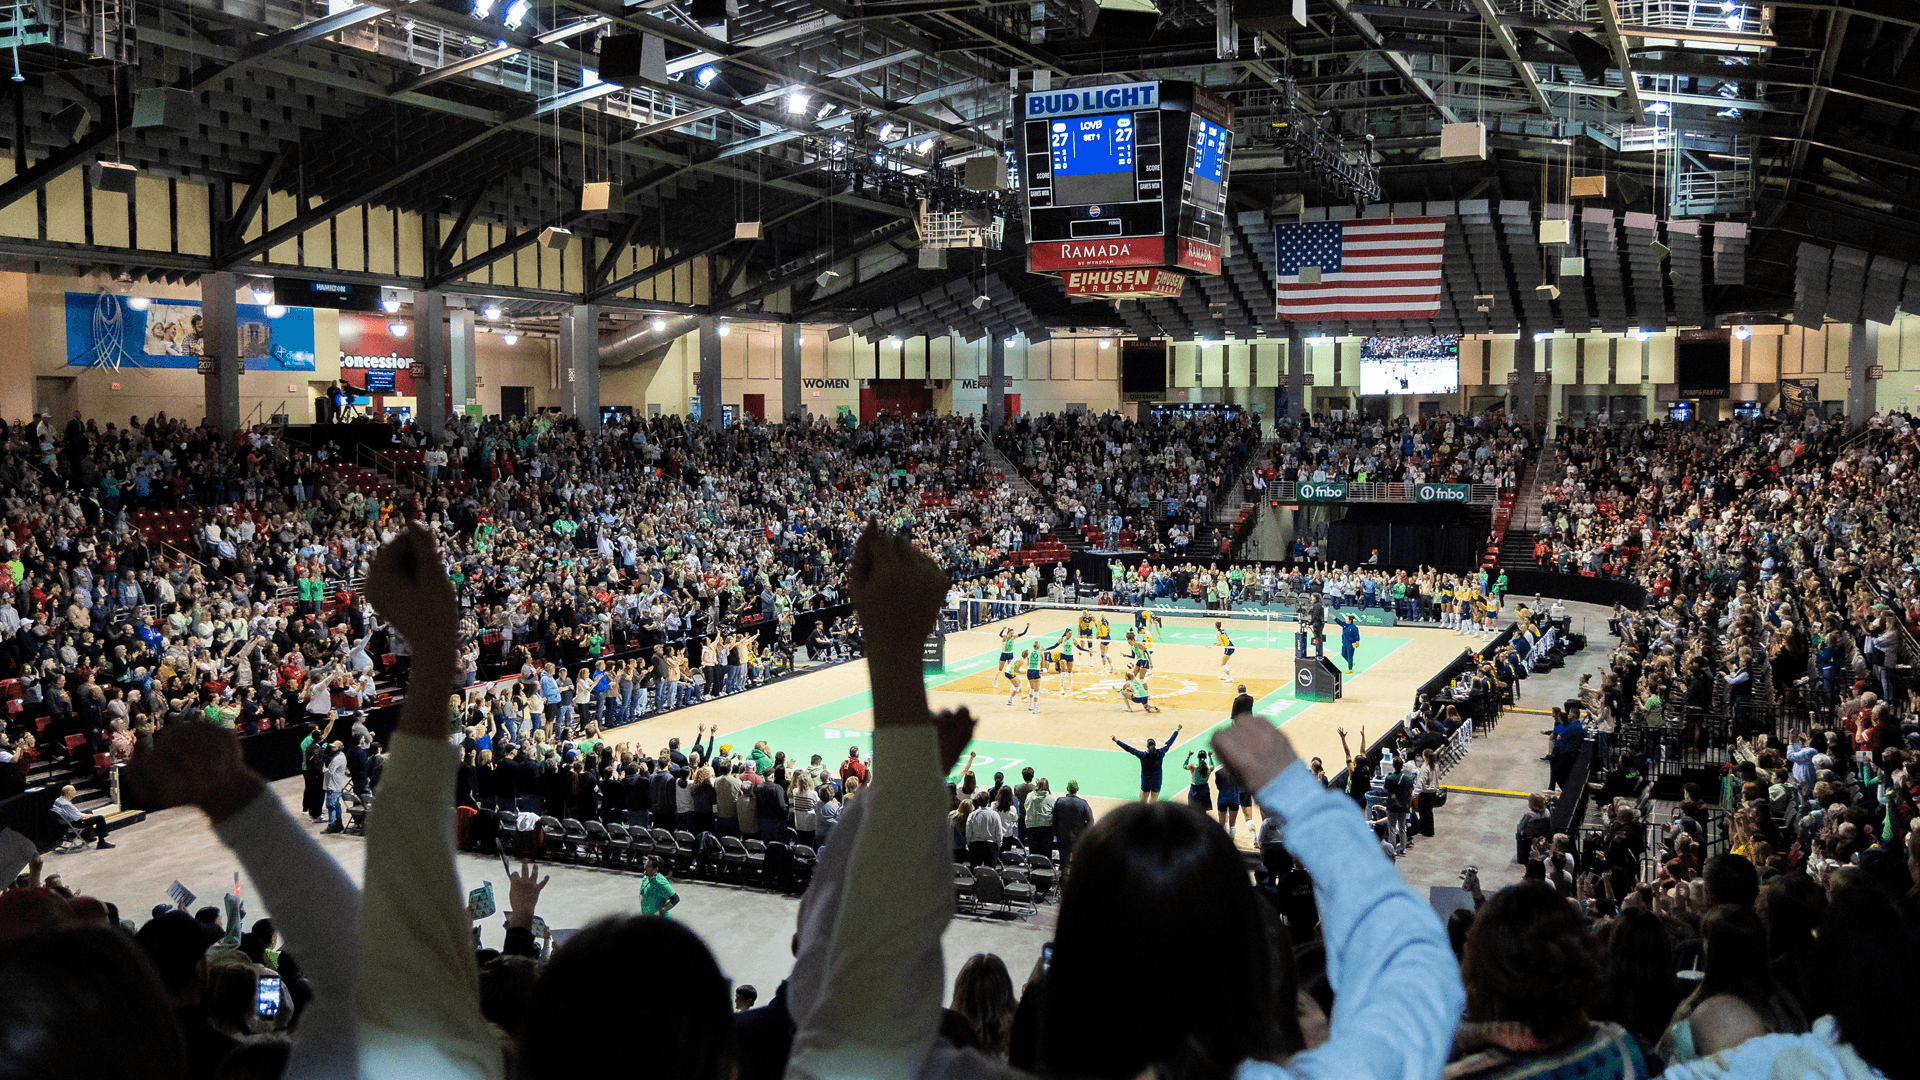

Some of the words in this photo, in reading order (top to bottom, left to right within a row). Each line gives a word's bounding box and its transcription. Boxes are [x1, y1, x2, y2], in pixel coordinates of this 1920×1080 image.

[1029, 93, 1079, 115] BUD
[1082, 86, 1155, 110] LIGHT
[1052, 132, 1069, 147] 27
[1083, 133, 1096, 142] SET
[1115, 127, 1133, 142] 27
[1061, 244, 1130, 259] RAMADA
[1188, 242, 1212, 261] RAMADA
[1068, 270, 1150, 288] EIHUSEN
[1154, 270, 1186, 290] EIHUSEN
[1080, 284, 1135, 292] ARENA
[198, 361, 211, 369] 207
[802, 379, 849, 388] WOMEN
[1315, 486, 1342, 497] fnbo
[1436, 488, 1464, 499] fnbo
